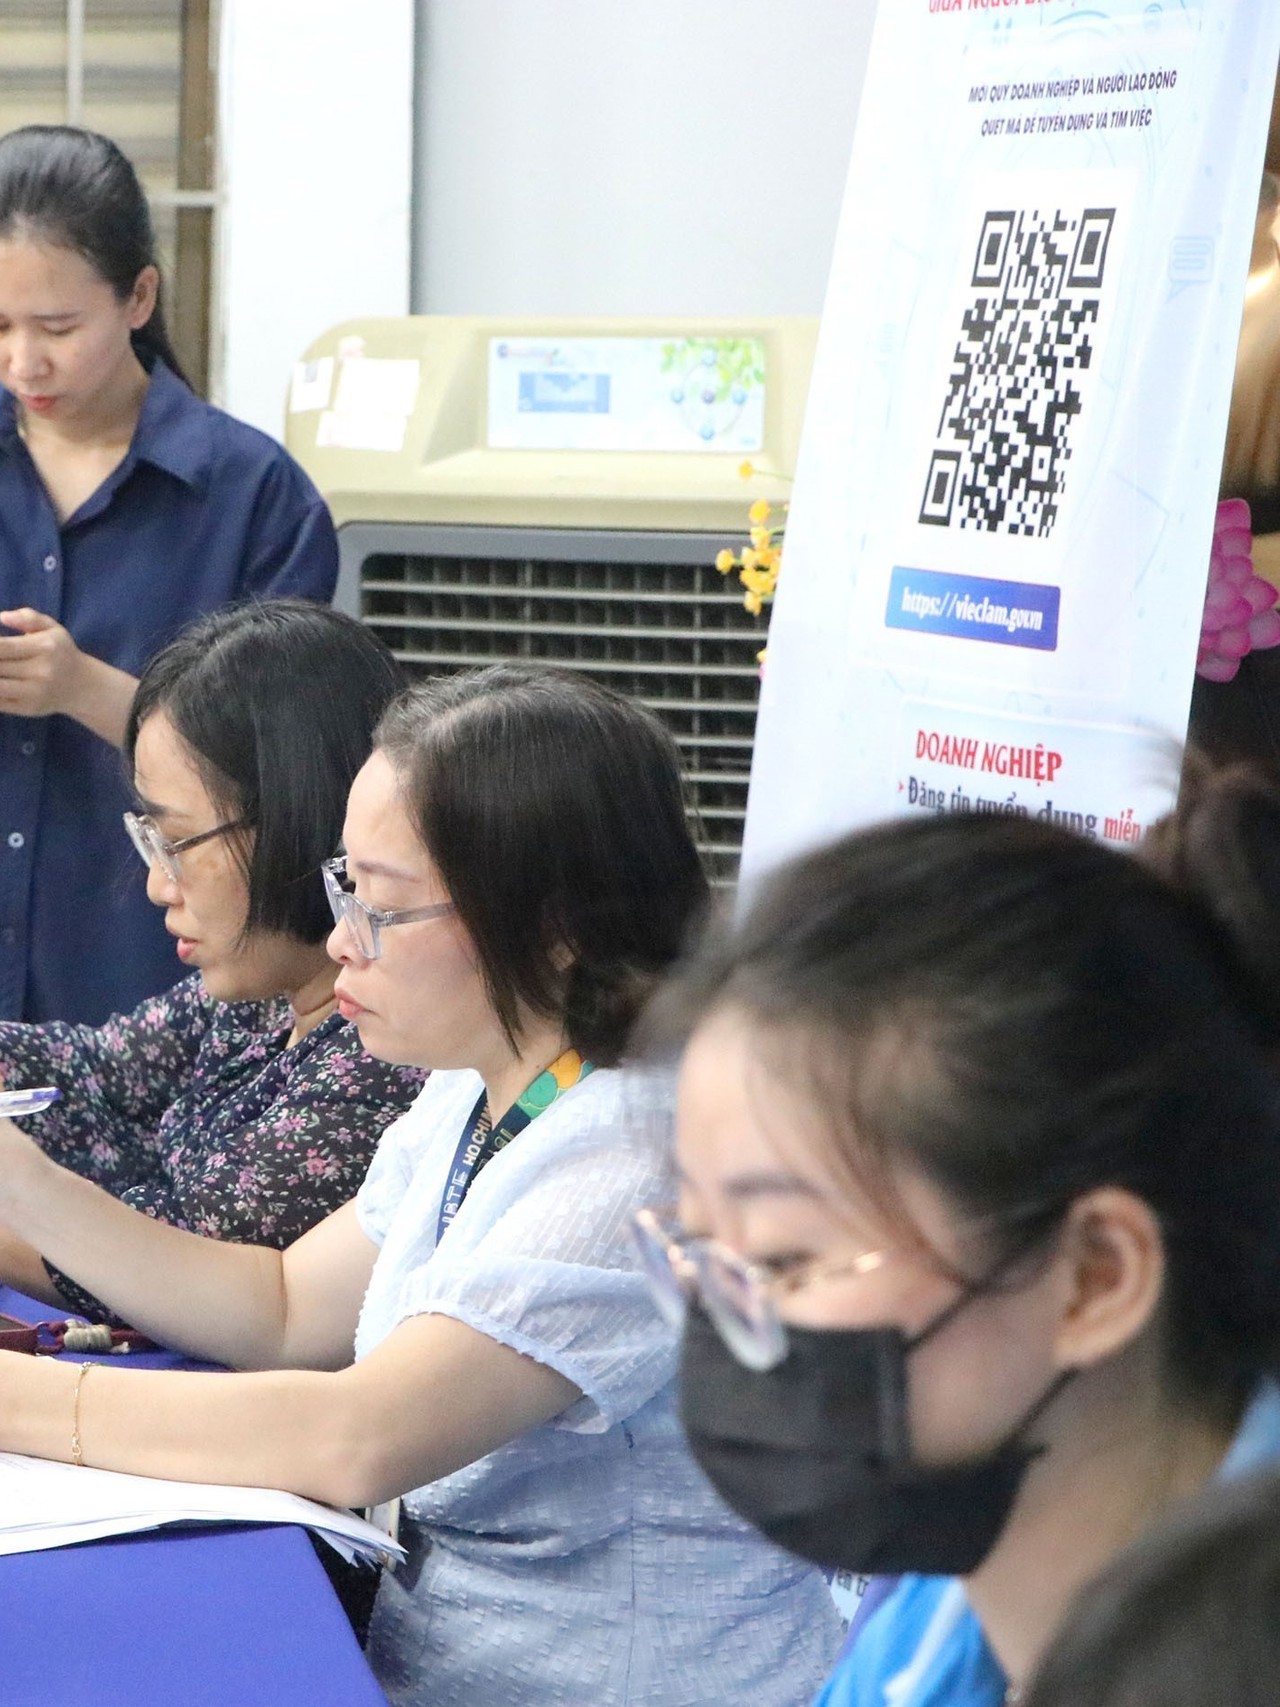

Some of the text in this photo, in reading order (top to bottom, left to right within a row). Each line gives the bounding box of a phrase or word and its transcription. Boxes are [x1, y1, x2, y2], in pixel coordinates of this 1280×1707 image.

[1010, 82, 1046, 100] DOANH
[1128, 73, 1147, 92] LAO
[915, 729, 1063, 787] DOANH NGHIỆP
